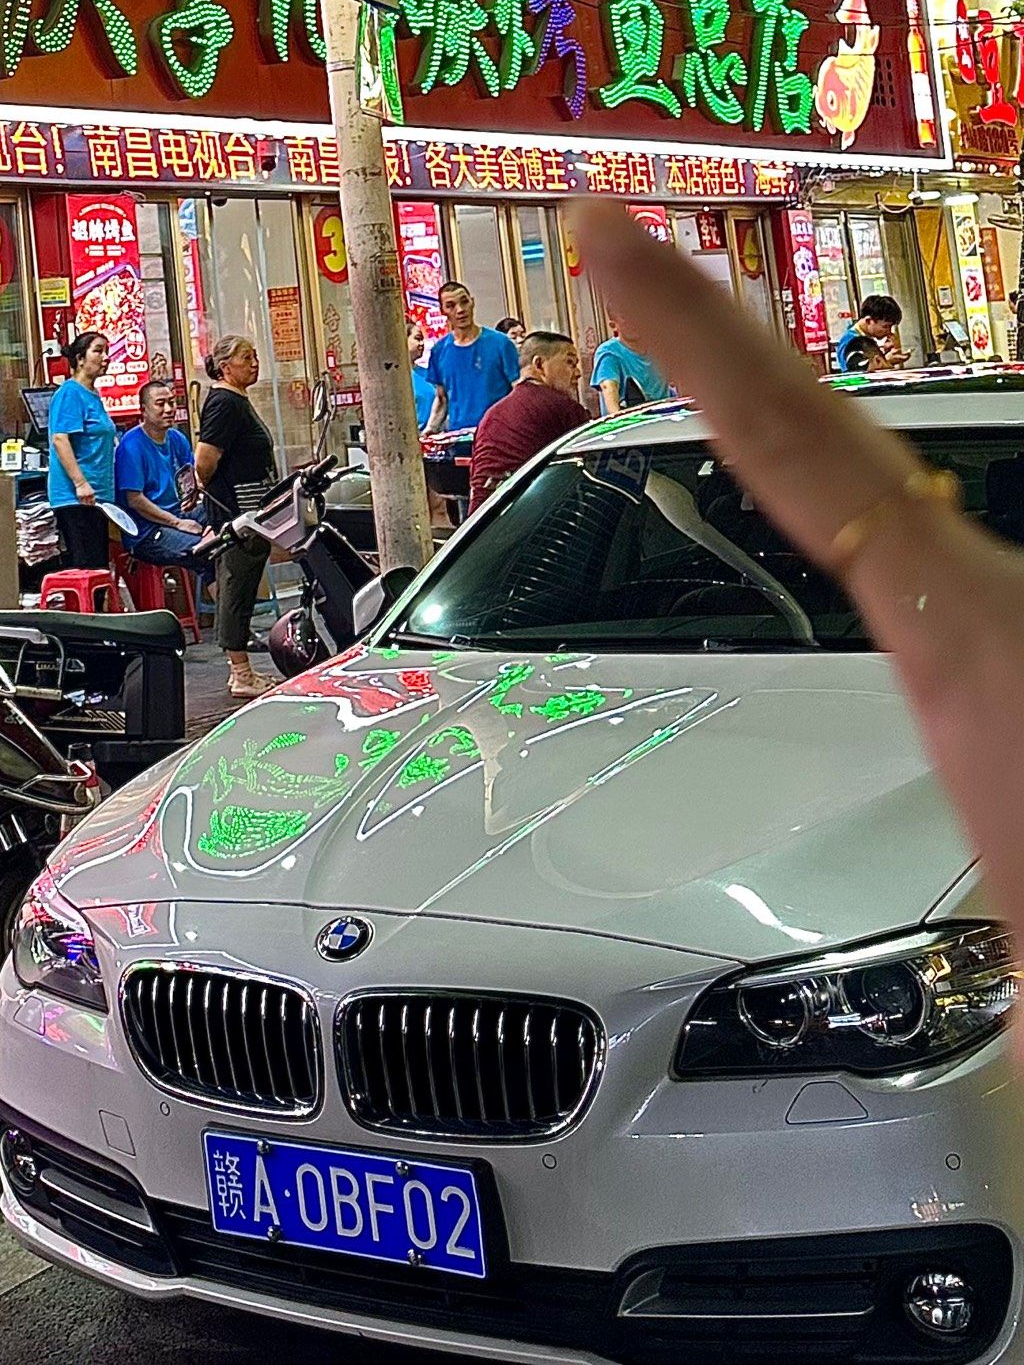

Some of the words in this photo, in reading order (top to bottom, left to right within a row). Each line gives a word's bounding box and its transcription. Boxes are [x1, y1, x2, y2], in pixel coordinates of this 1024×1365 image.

[72, 218, 136, 243] 招牌烤鱼
[322, 215, 347, 274] 3
